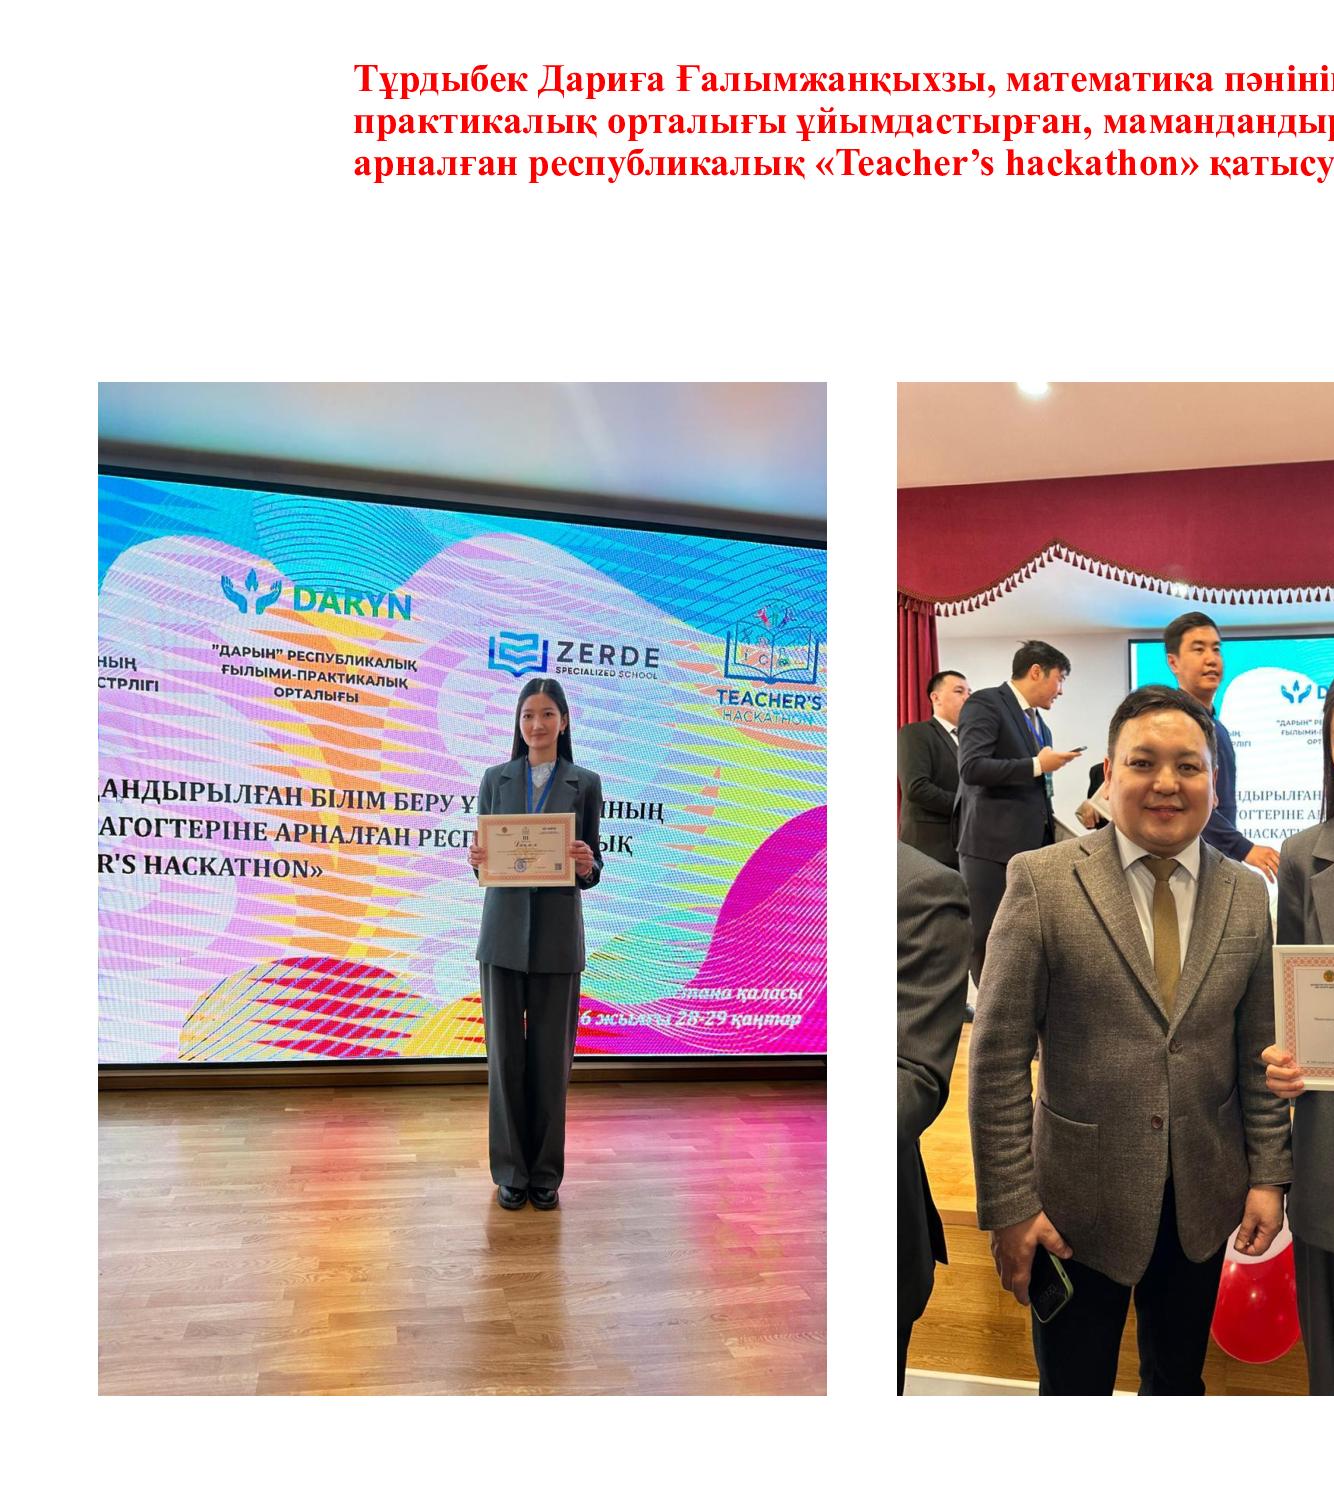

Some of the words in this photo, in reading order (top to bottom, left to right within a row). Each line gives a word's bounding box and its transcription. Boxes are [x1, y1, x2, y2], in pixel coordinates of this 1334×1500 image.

[292, 586, 412, 621] DARYN
[287, 650, 417, 672] РЕСПУБЛИКАЛЫҚ
[557, 641, 660, 668] ZERDE
[221, 664, 408, 690] ҒЫЛЫМИ-ПРАКТИКАЛЫҚ
[555, 666, 616, 678] SPECIALIZED
[618, 669, 658, 680] SCHOOL
[273, 686, 359, 703] ОРТАЛЫҒЫ
[716, 688, 822, 711] TEACHER'S
[98, 778, 302, 806] АНДЫРЫЛҒАН
[310, 789, 386, 811] БІЛІМ
[394, 792, 455, 813] БЕРУ
[274, 822, 411, 848] АРНАЛҒАН
[144, 855, 324, 879] HACKATHON»
